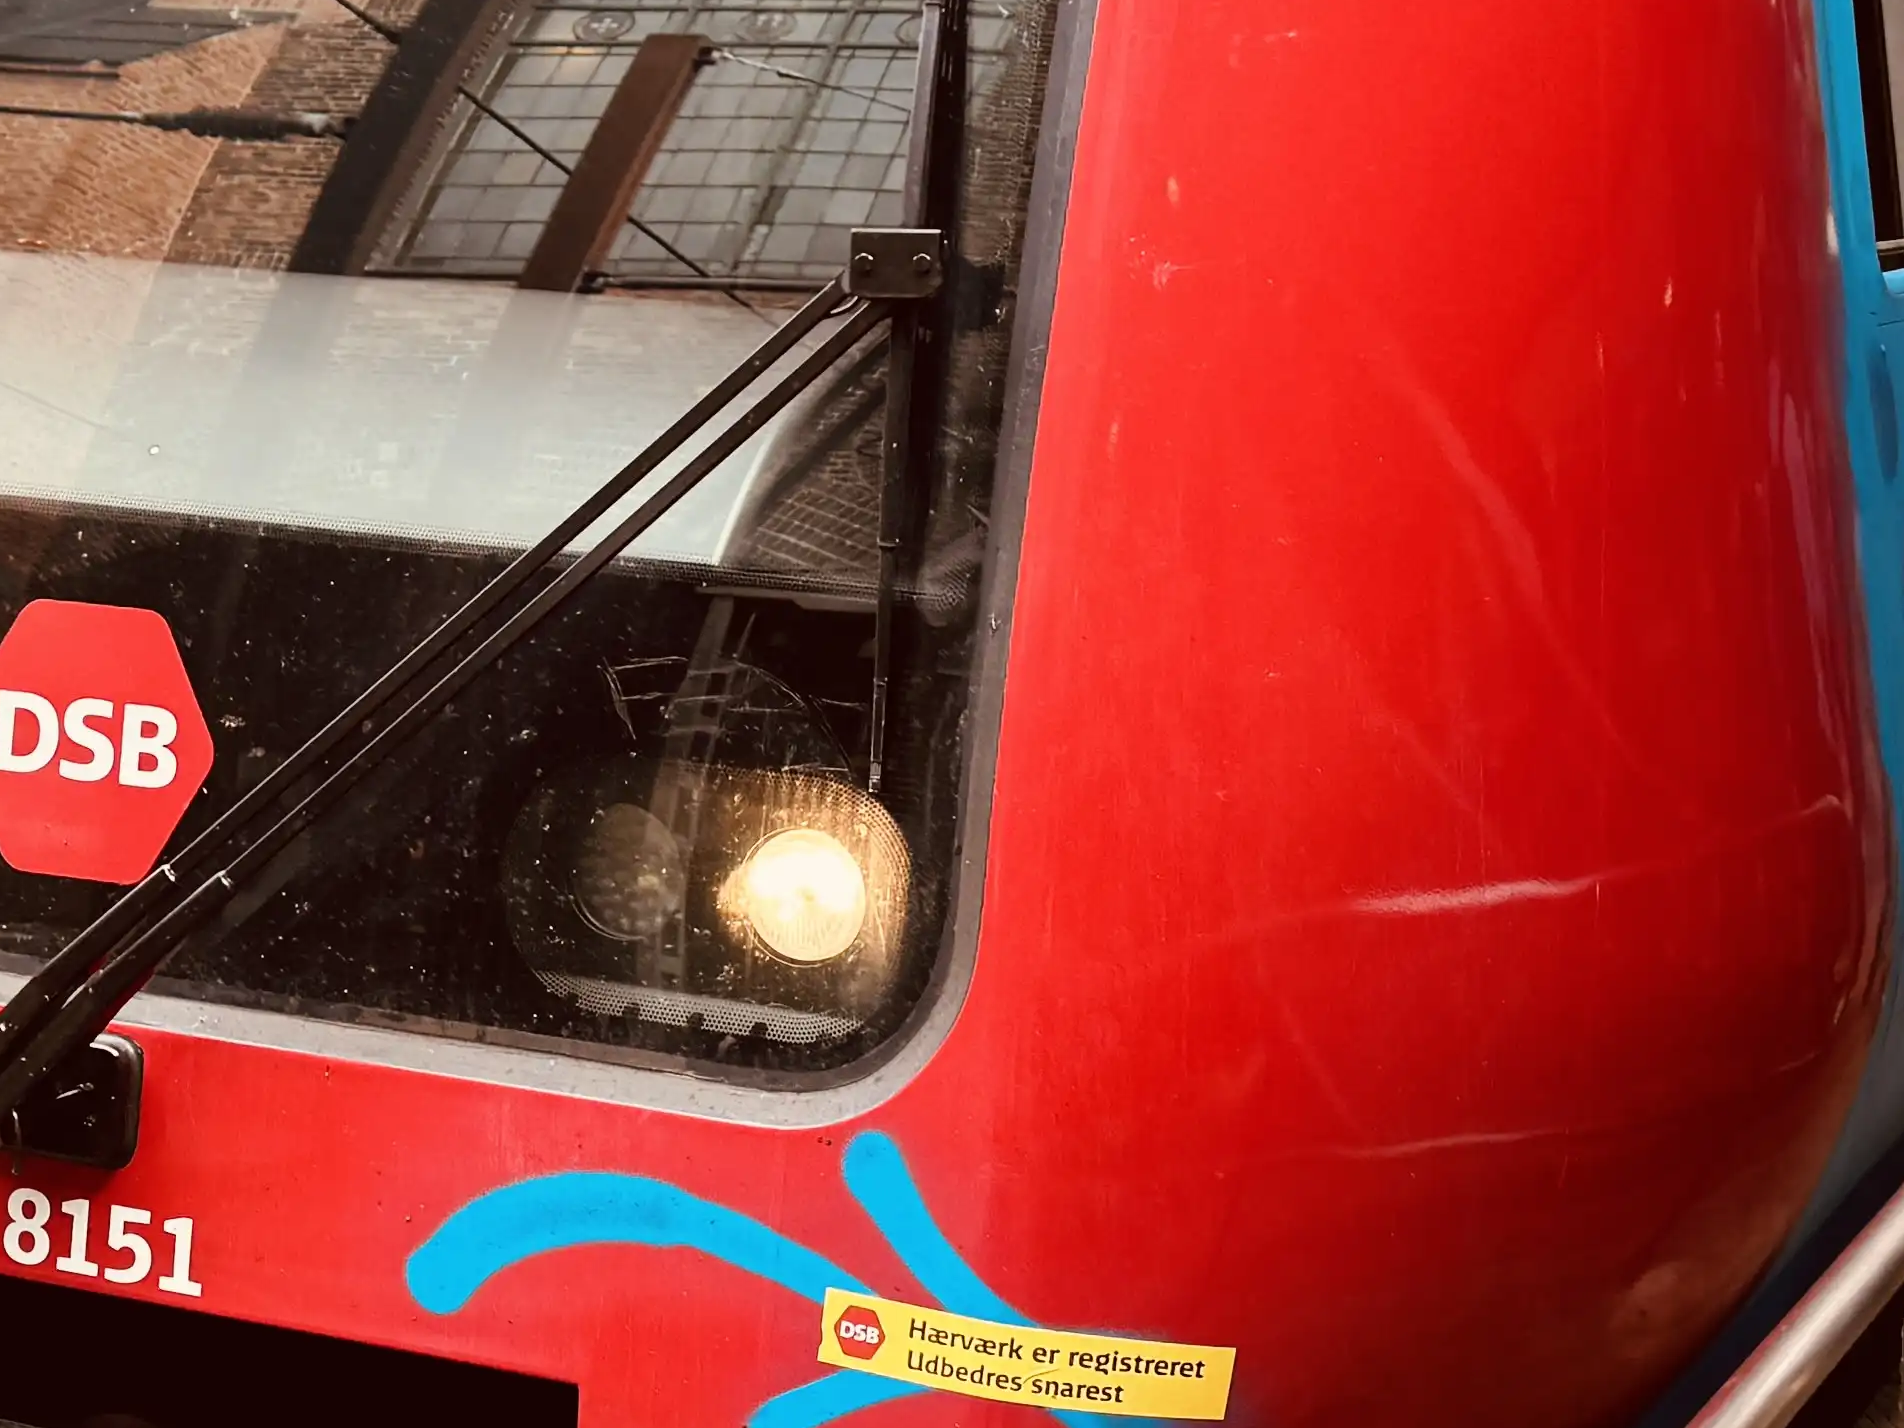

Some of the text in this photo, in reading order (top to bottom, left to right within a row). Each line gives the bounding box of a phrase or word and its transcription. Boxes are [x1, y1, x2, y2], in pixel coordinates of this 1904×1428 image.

[3, 1187, 203, 1297] 8151
[839, 1320, 880, 1345] DSB
[908, 1318, 1206, 1379] Hærværk er registreret
[906, 1351, 1124, 1403] Udbedres snarest
